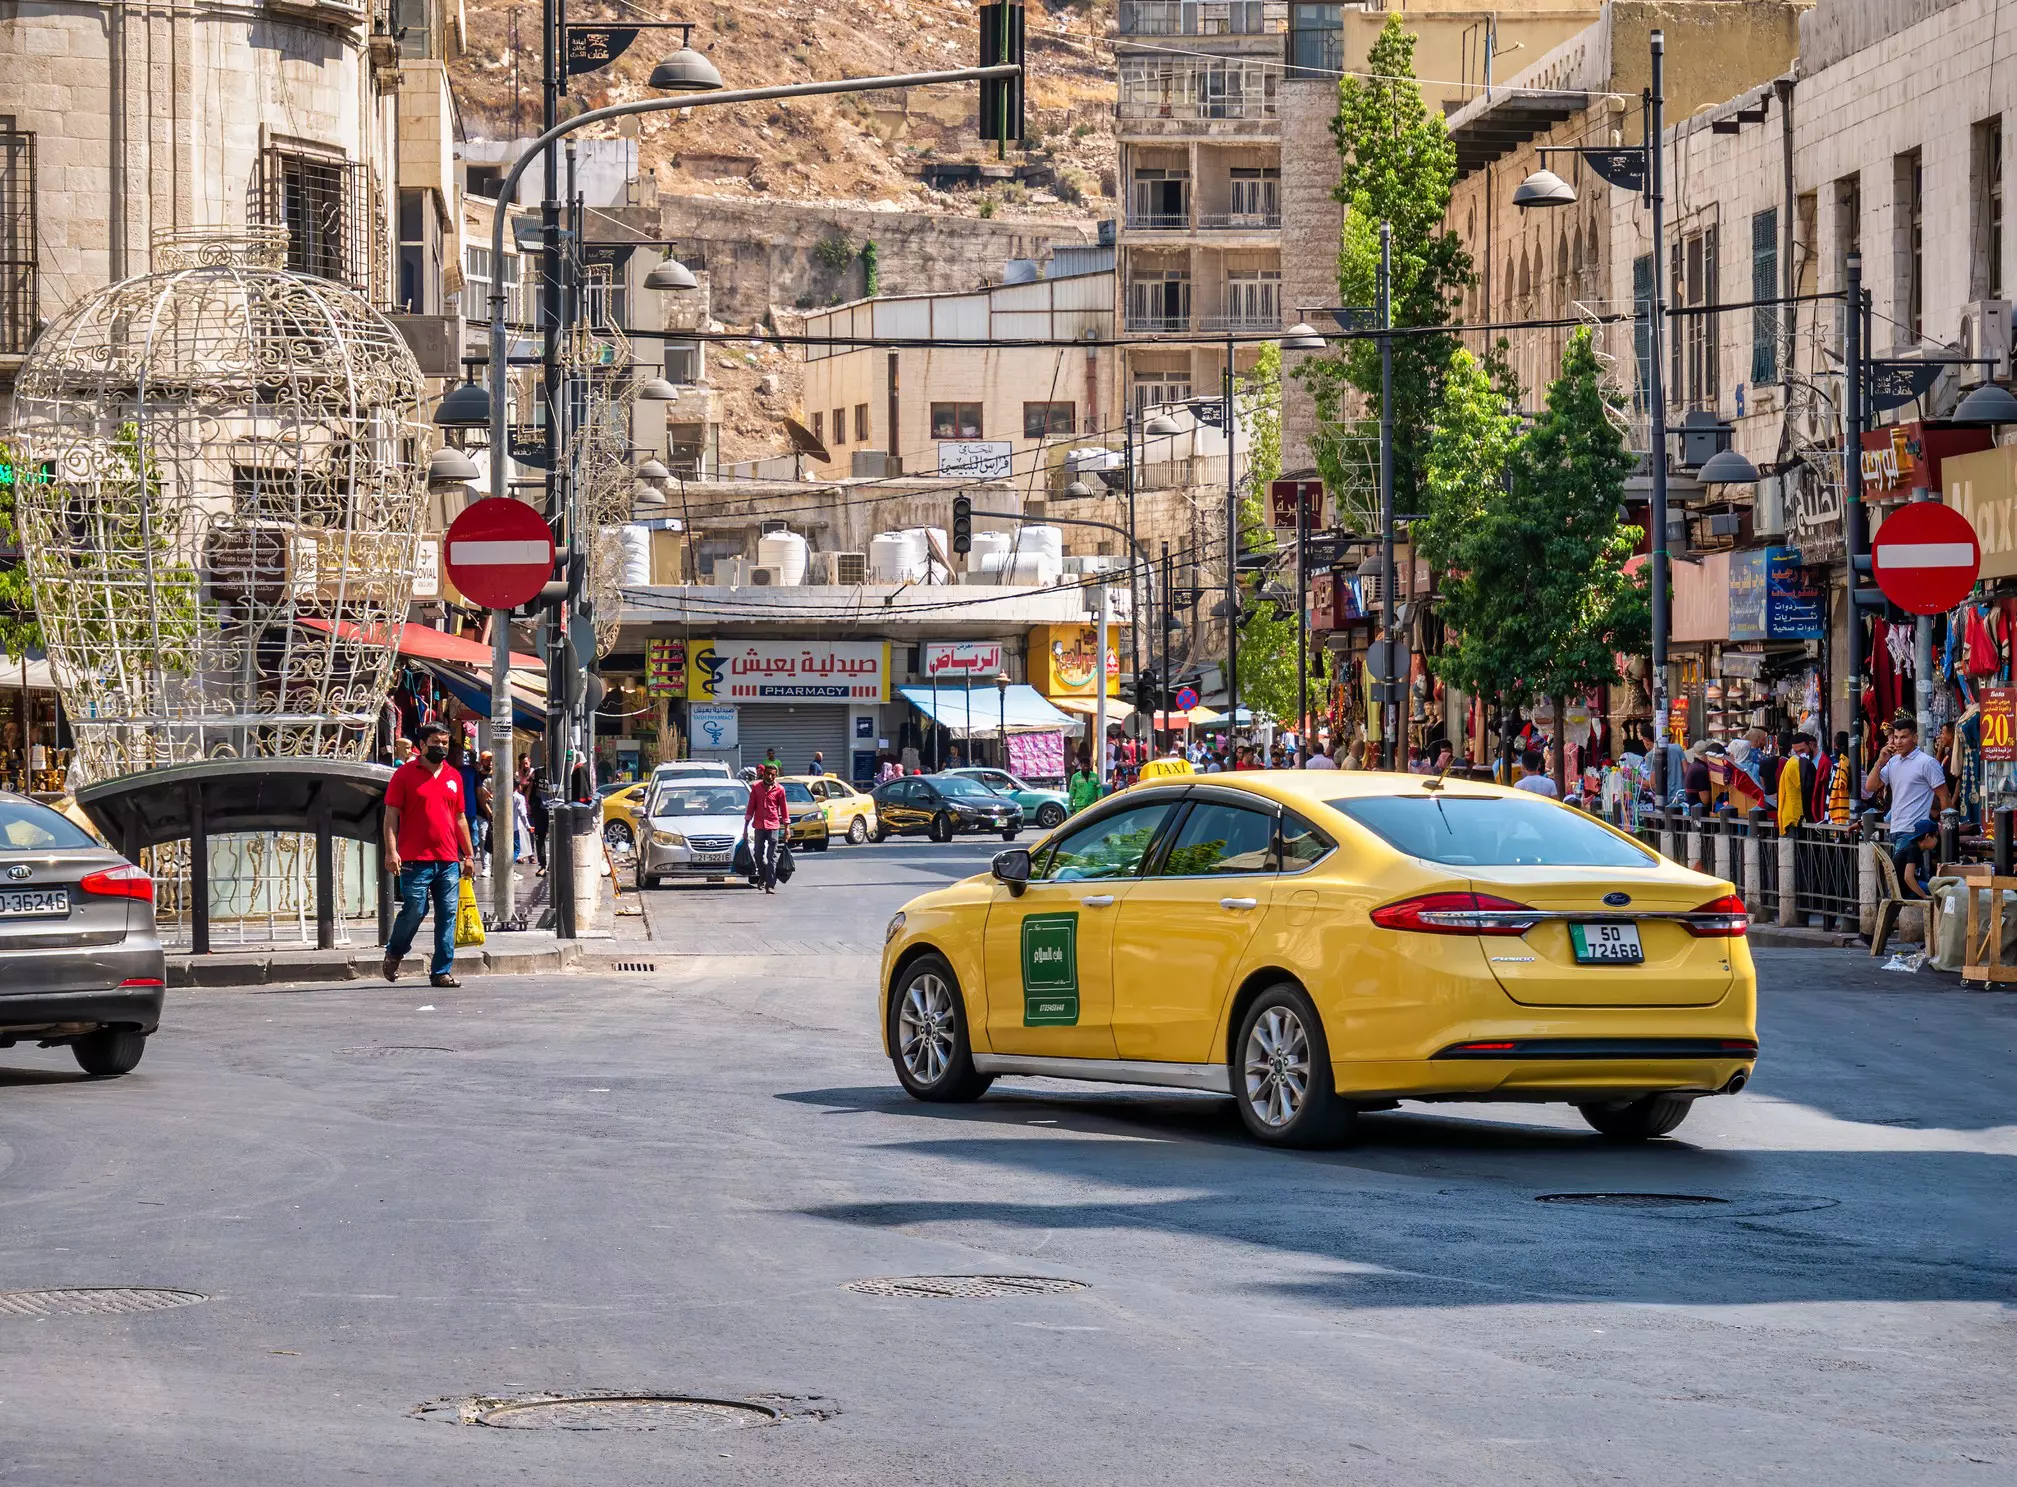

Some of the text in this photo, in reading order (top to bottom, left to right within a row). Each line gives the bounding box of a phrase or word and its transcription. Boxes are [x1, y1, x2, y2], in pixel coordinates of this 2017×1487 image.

[1952, 481, 2017, 556] Max
[1772, 624, 1795, 633] صحية
[731, 647, 877, 678] صيدلية يعيش
[929, 647, 999, 674] الرياض
[765, 686, 845, 696] PHARMACY
[1154, 761, 1186, 775] TAXI
[11, 867, 30, 877] KIA
[1601, 926, 1621, 941] 50
[1588, 943, 1640, 958] 72468
